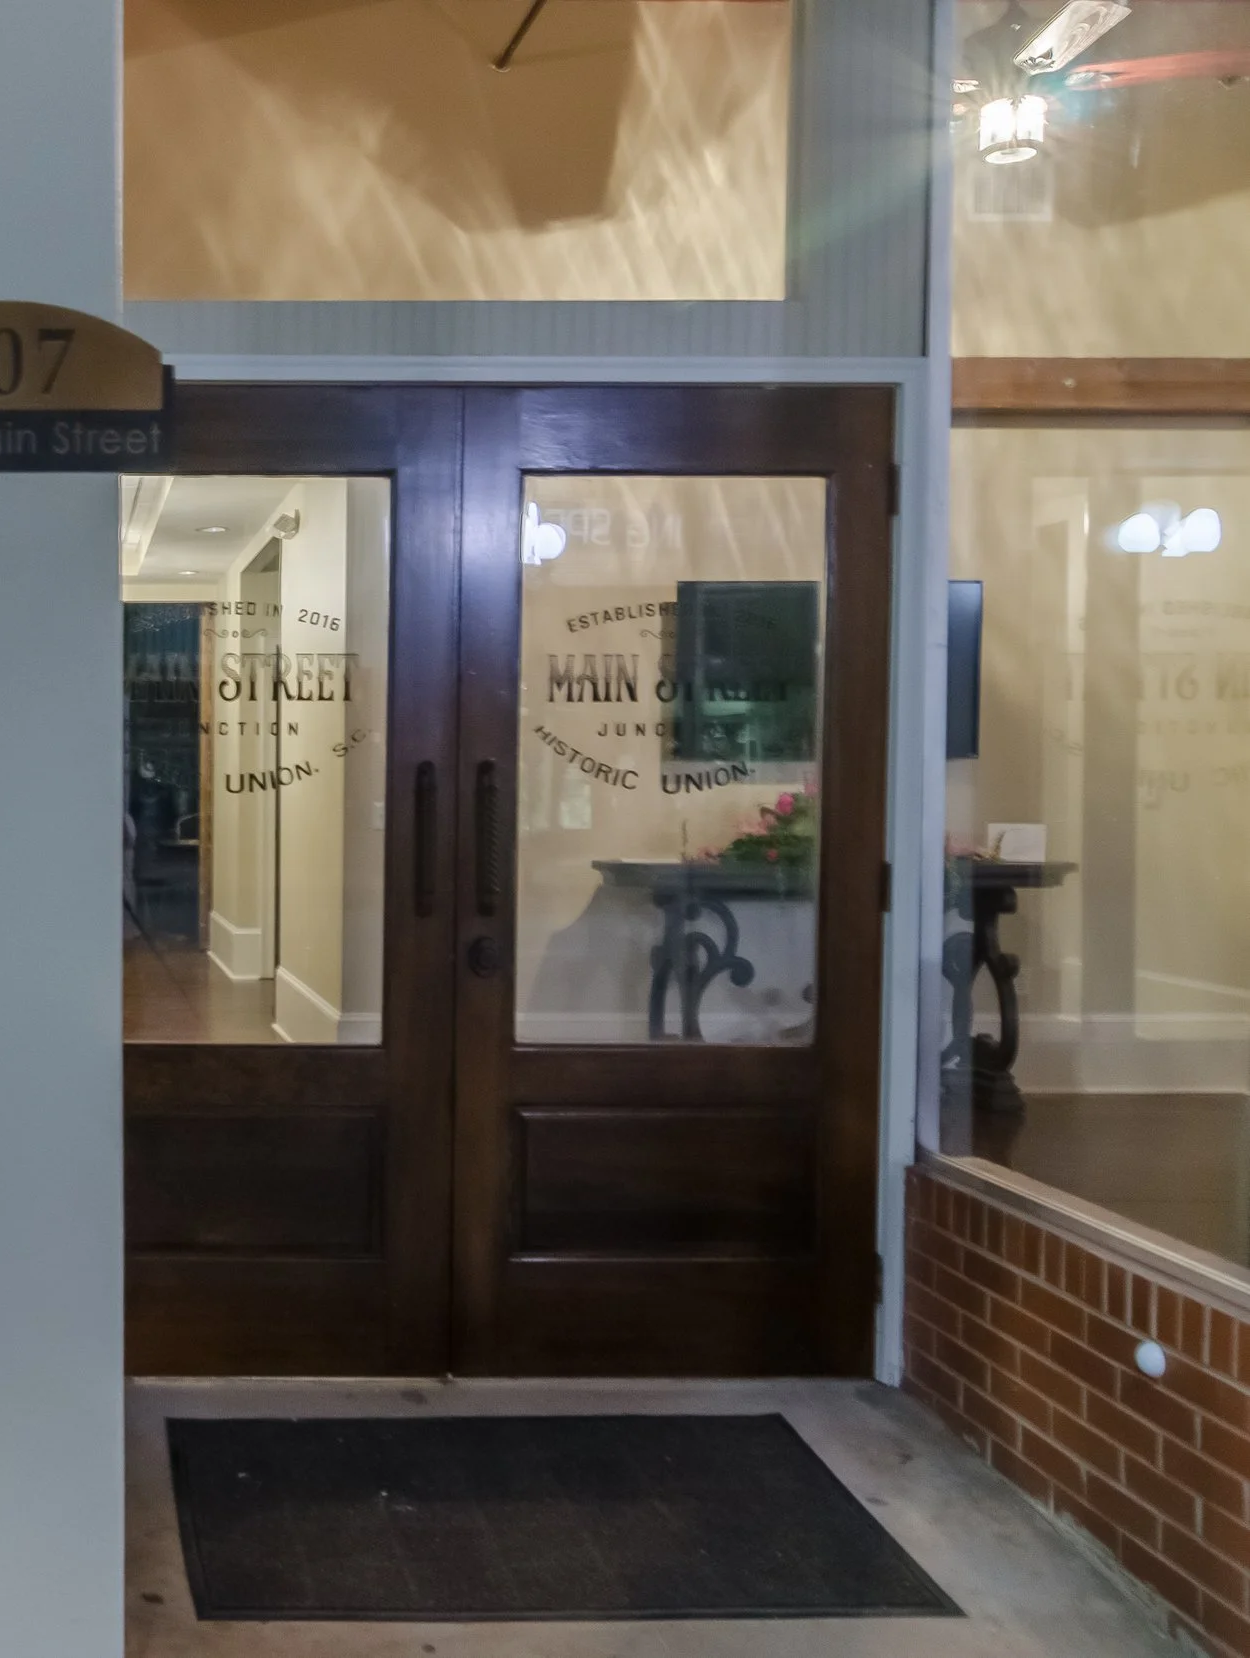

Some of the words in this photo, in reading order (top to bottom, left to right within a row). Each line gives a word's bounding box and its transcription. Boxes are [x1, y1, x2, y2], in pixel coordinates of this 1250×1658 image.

[53, 421, 163, 455] Street
[297, 608, 341, 631] 2016
[218, 652, 360, 702] STREET
[546, 654, 639, 702] MAIN
[199, 721, 299, 736] NCTION
[533, 725, 639, 790] HISTORIC
